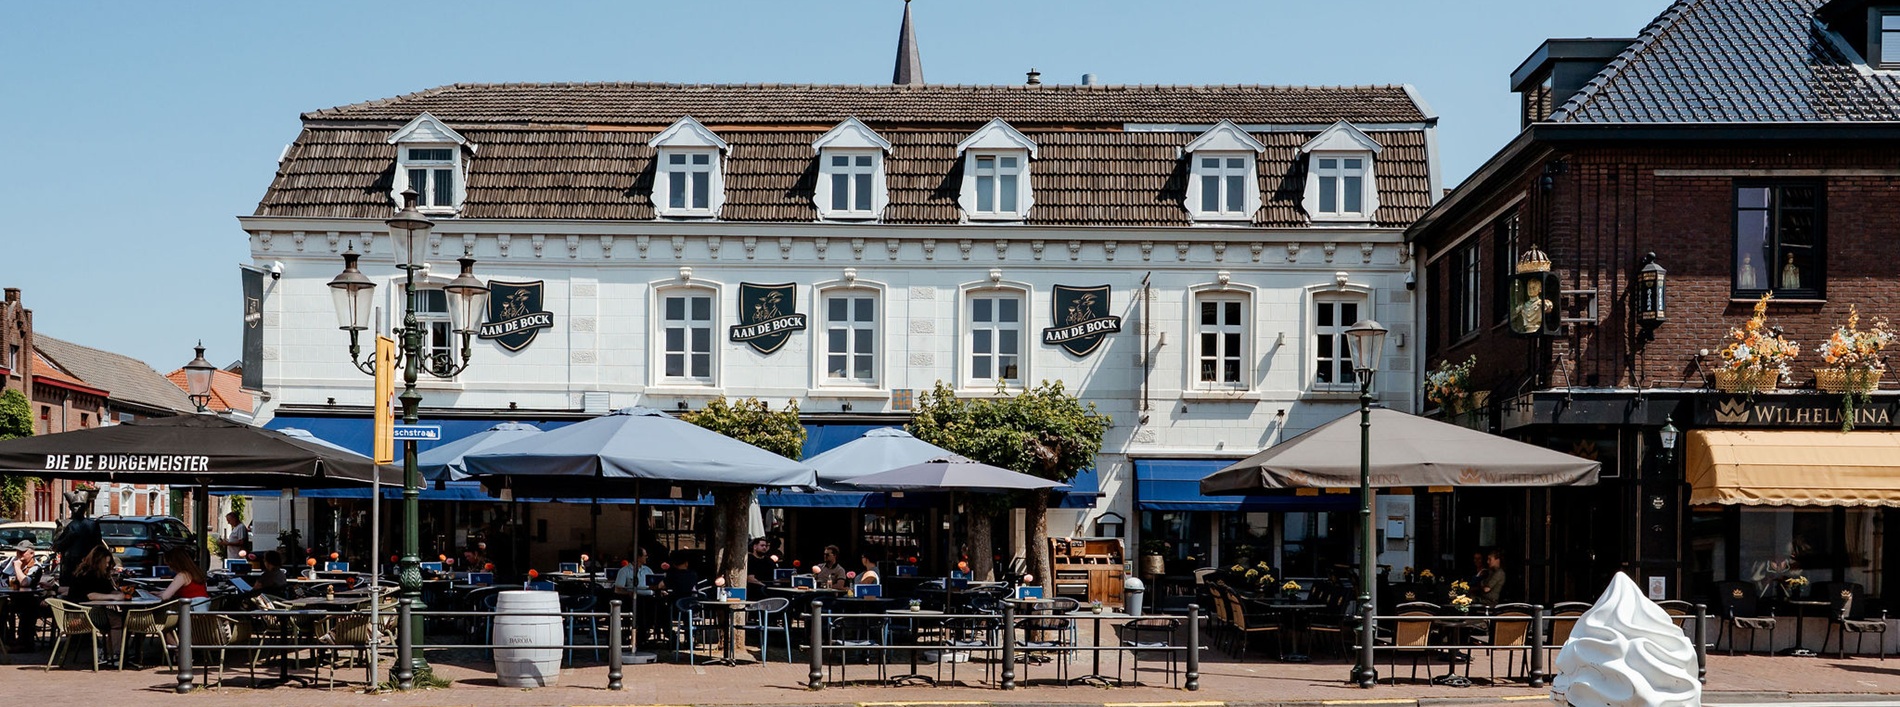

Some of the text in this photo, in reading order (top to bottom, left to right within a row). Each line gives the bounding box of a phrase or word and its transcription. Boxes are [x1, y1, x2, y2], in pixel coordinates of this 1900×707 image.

[480, 314, 551, 336] AAN DE BOCK
[732, 317, 803, 338] AAN DE BOCK
[1046, 319, 1117, 341] AAN DE BOCK
[393, 429, 435, 438] schstraat
[45, 454, 209, 472] BIE DE BURGEMEISTER
